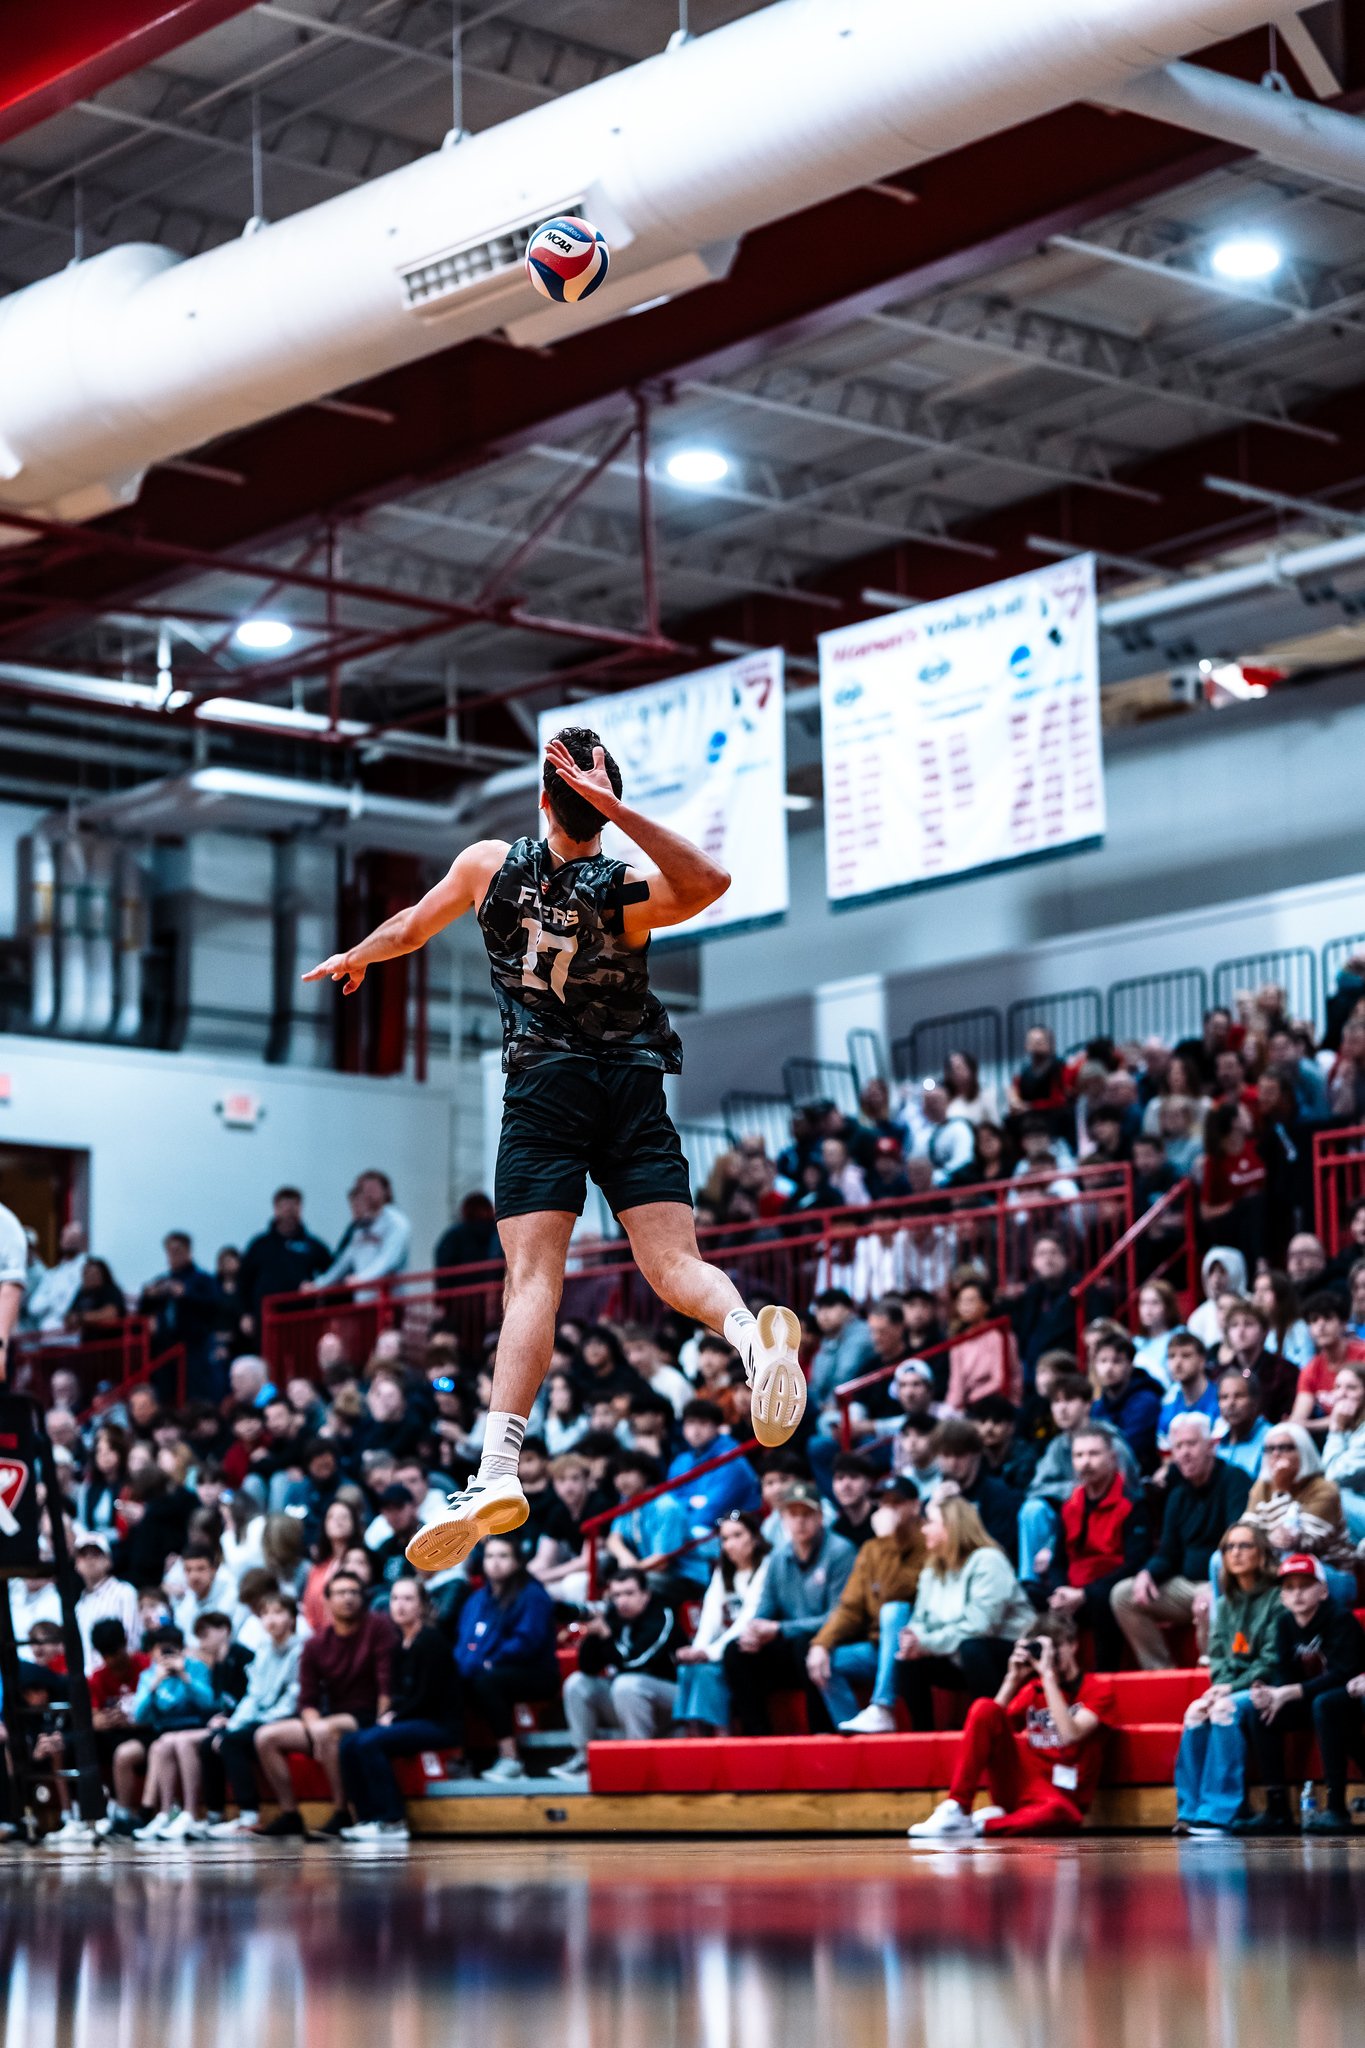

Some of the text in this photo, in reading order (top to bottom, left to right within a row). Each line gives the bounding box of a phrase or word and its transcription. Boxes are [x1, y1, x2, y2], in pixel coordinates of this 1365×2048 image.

[544, 231, 573, 253] NCAA
[556, 222, 581, 240] molten
[521, 917, 578, 1004] 17
